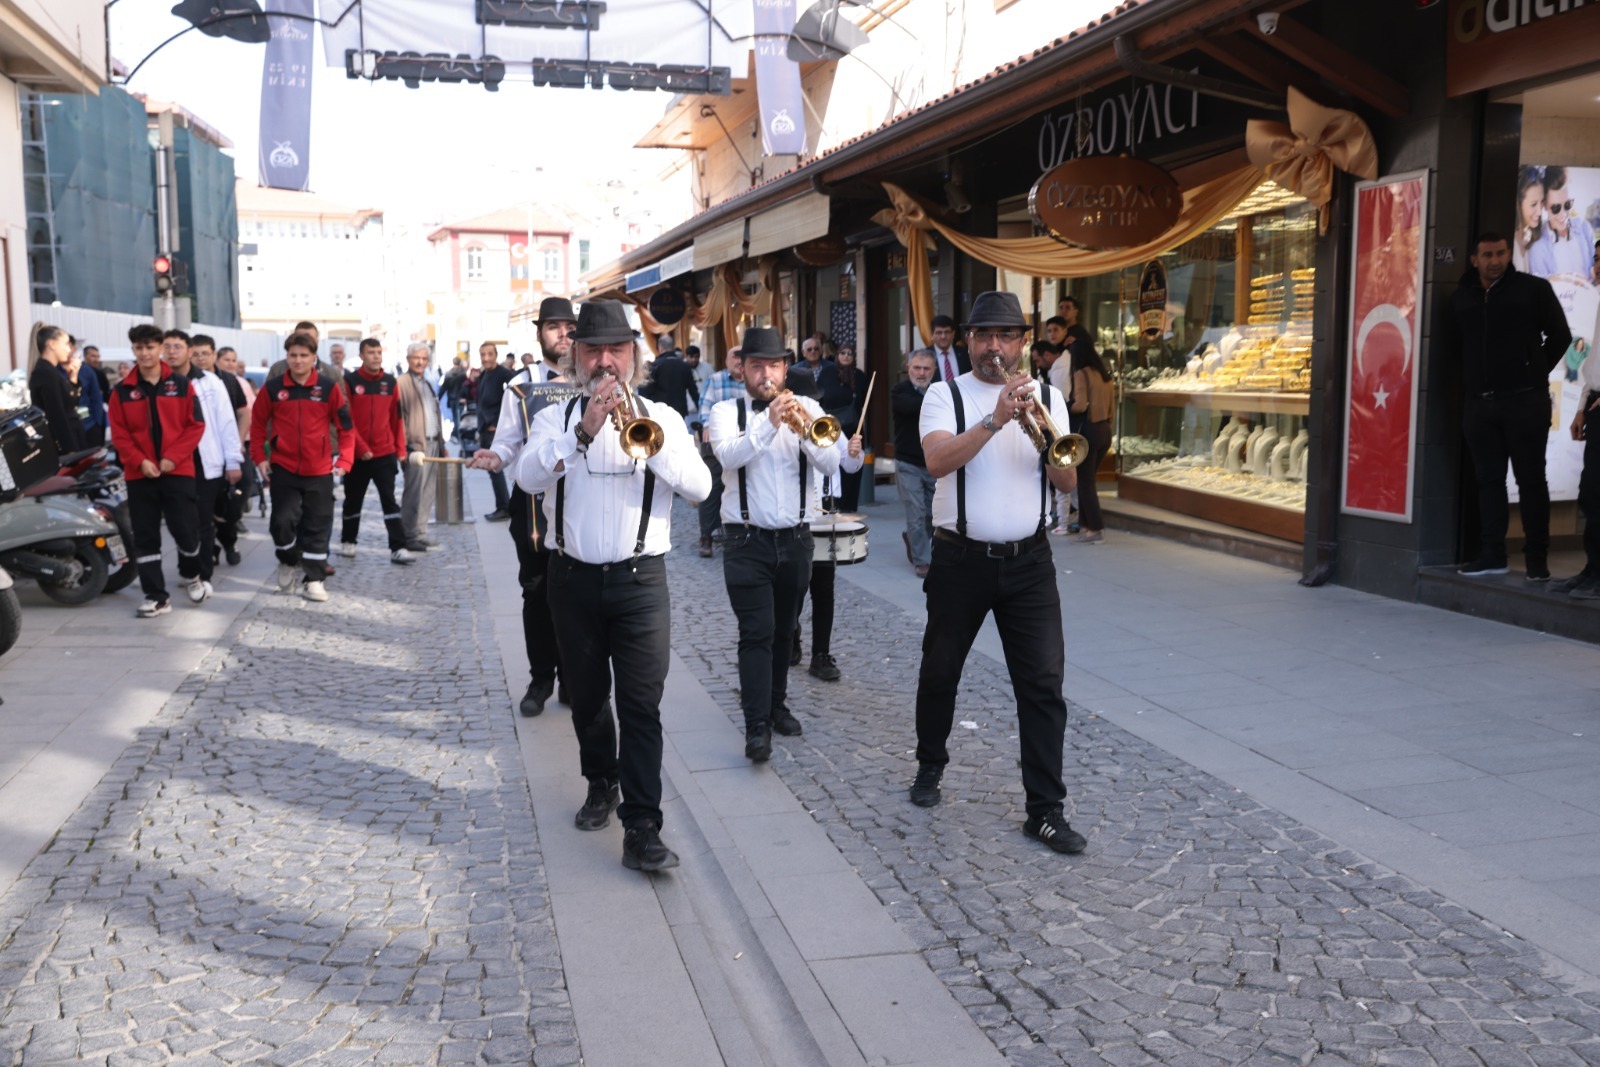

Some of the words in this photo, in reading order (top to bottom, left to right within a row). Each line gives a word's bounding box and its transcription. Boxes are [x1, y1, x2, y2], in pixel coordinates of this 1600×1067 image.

[1038, 66, 1200, 173] ÖZBOYACI
[1046, 181, 1173, 208] ÖZBOYACI
[1080, 211, 1139, 226] ALTIN
